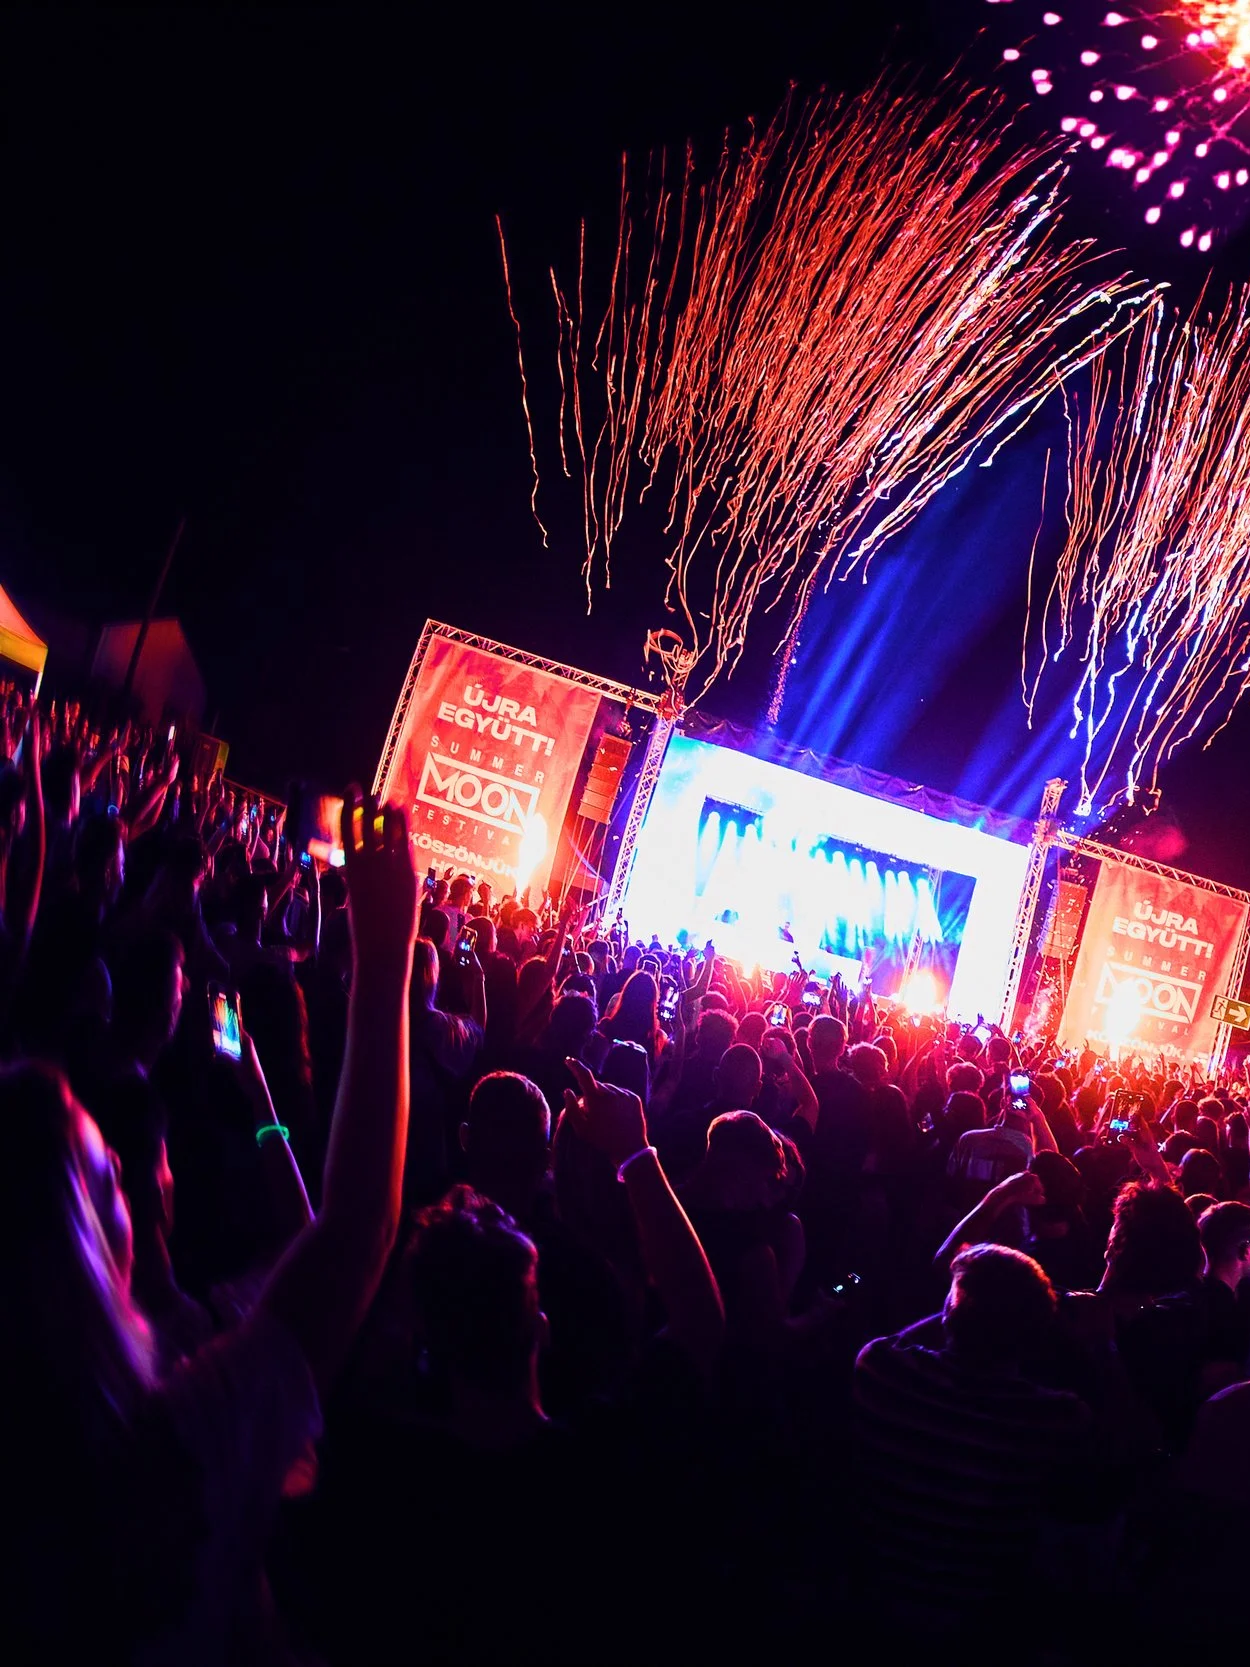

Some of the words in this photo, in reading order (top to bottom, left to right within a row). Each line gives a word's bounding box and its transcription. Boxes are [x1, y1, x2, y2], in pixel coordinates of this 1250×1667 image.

[463, 683, 537, 727] ÚJRA
[437, 701, 556, 757] EGYÜTT!
[430, 735, 545, 783] SUMMER
[416, 752, 541, 836] MOON
[411, 804, 511, 846] FESTIVA
[1112, 916, 1214, 959] EGYÜTT!
[1133, 899, 1199, 936] ÚJRA
[1106, 946, 1207, 981] SUMMER
